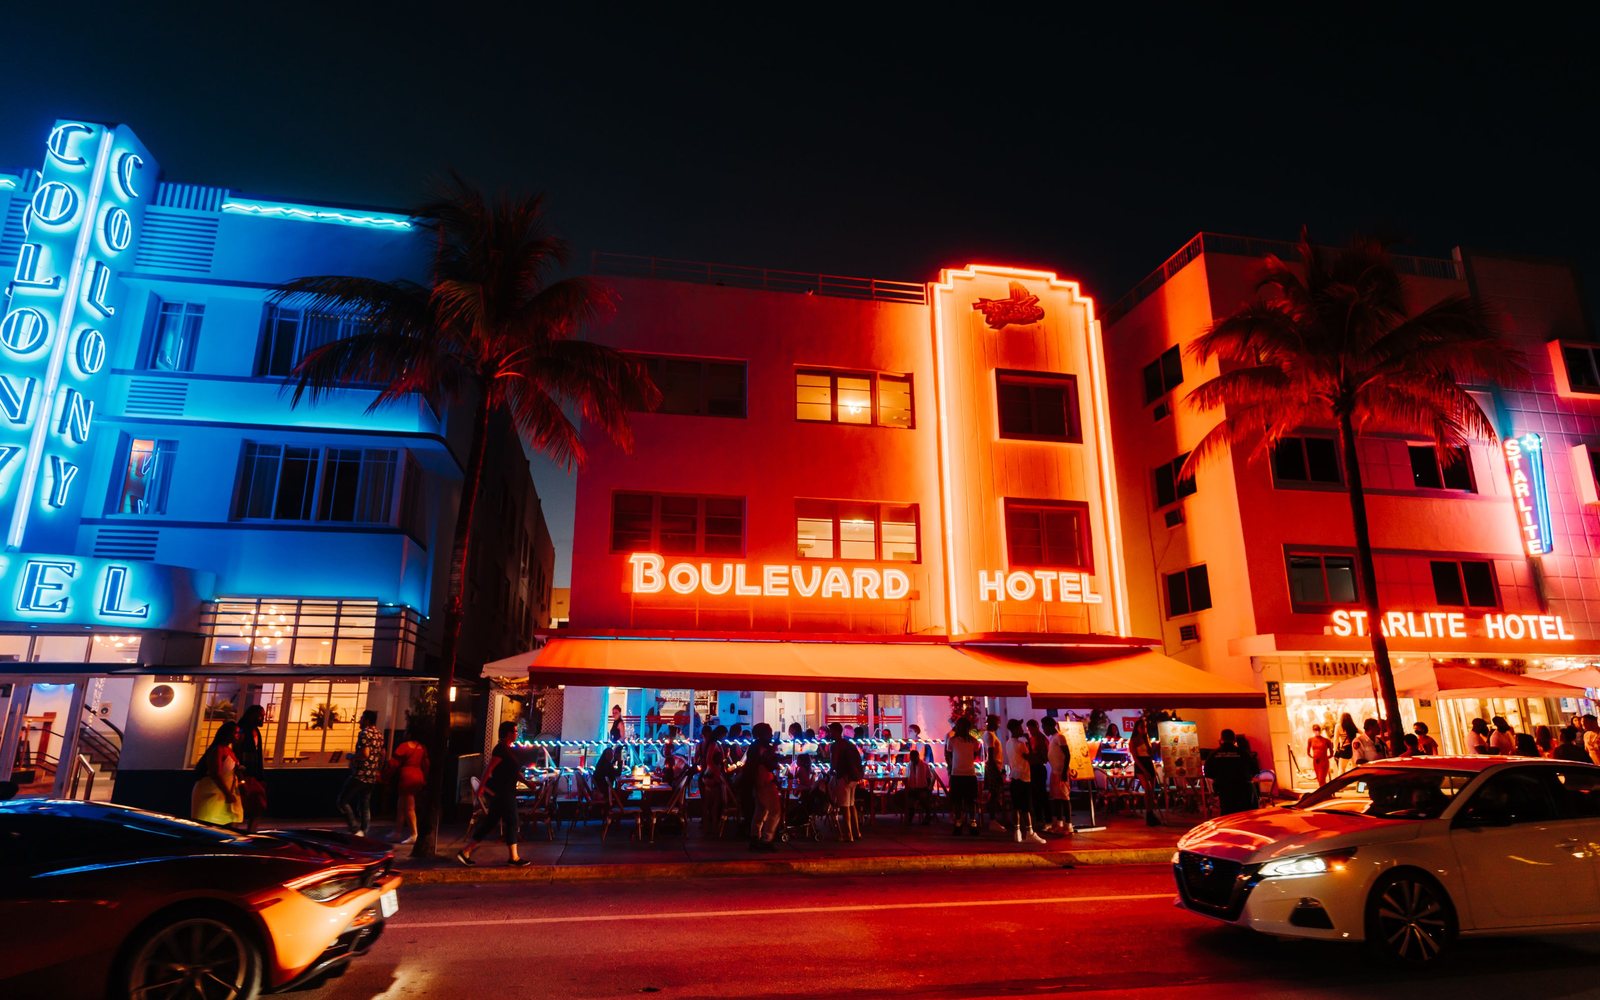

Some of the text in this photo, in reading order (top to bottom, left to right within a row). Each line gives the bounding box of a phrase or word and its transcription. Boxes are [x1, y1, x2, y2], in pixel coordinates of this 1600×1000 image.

[48, 152, 144, 508] COLONY
[1504, 438, 1543, 555] STARLITE
[628, 552, 1103, 604] BOULEVARD HOTEL
[1484, 613, 1575, 640] HOTEL
